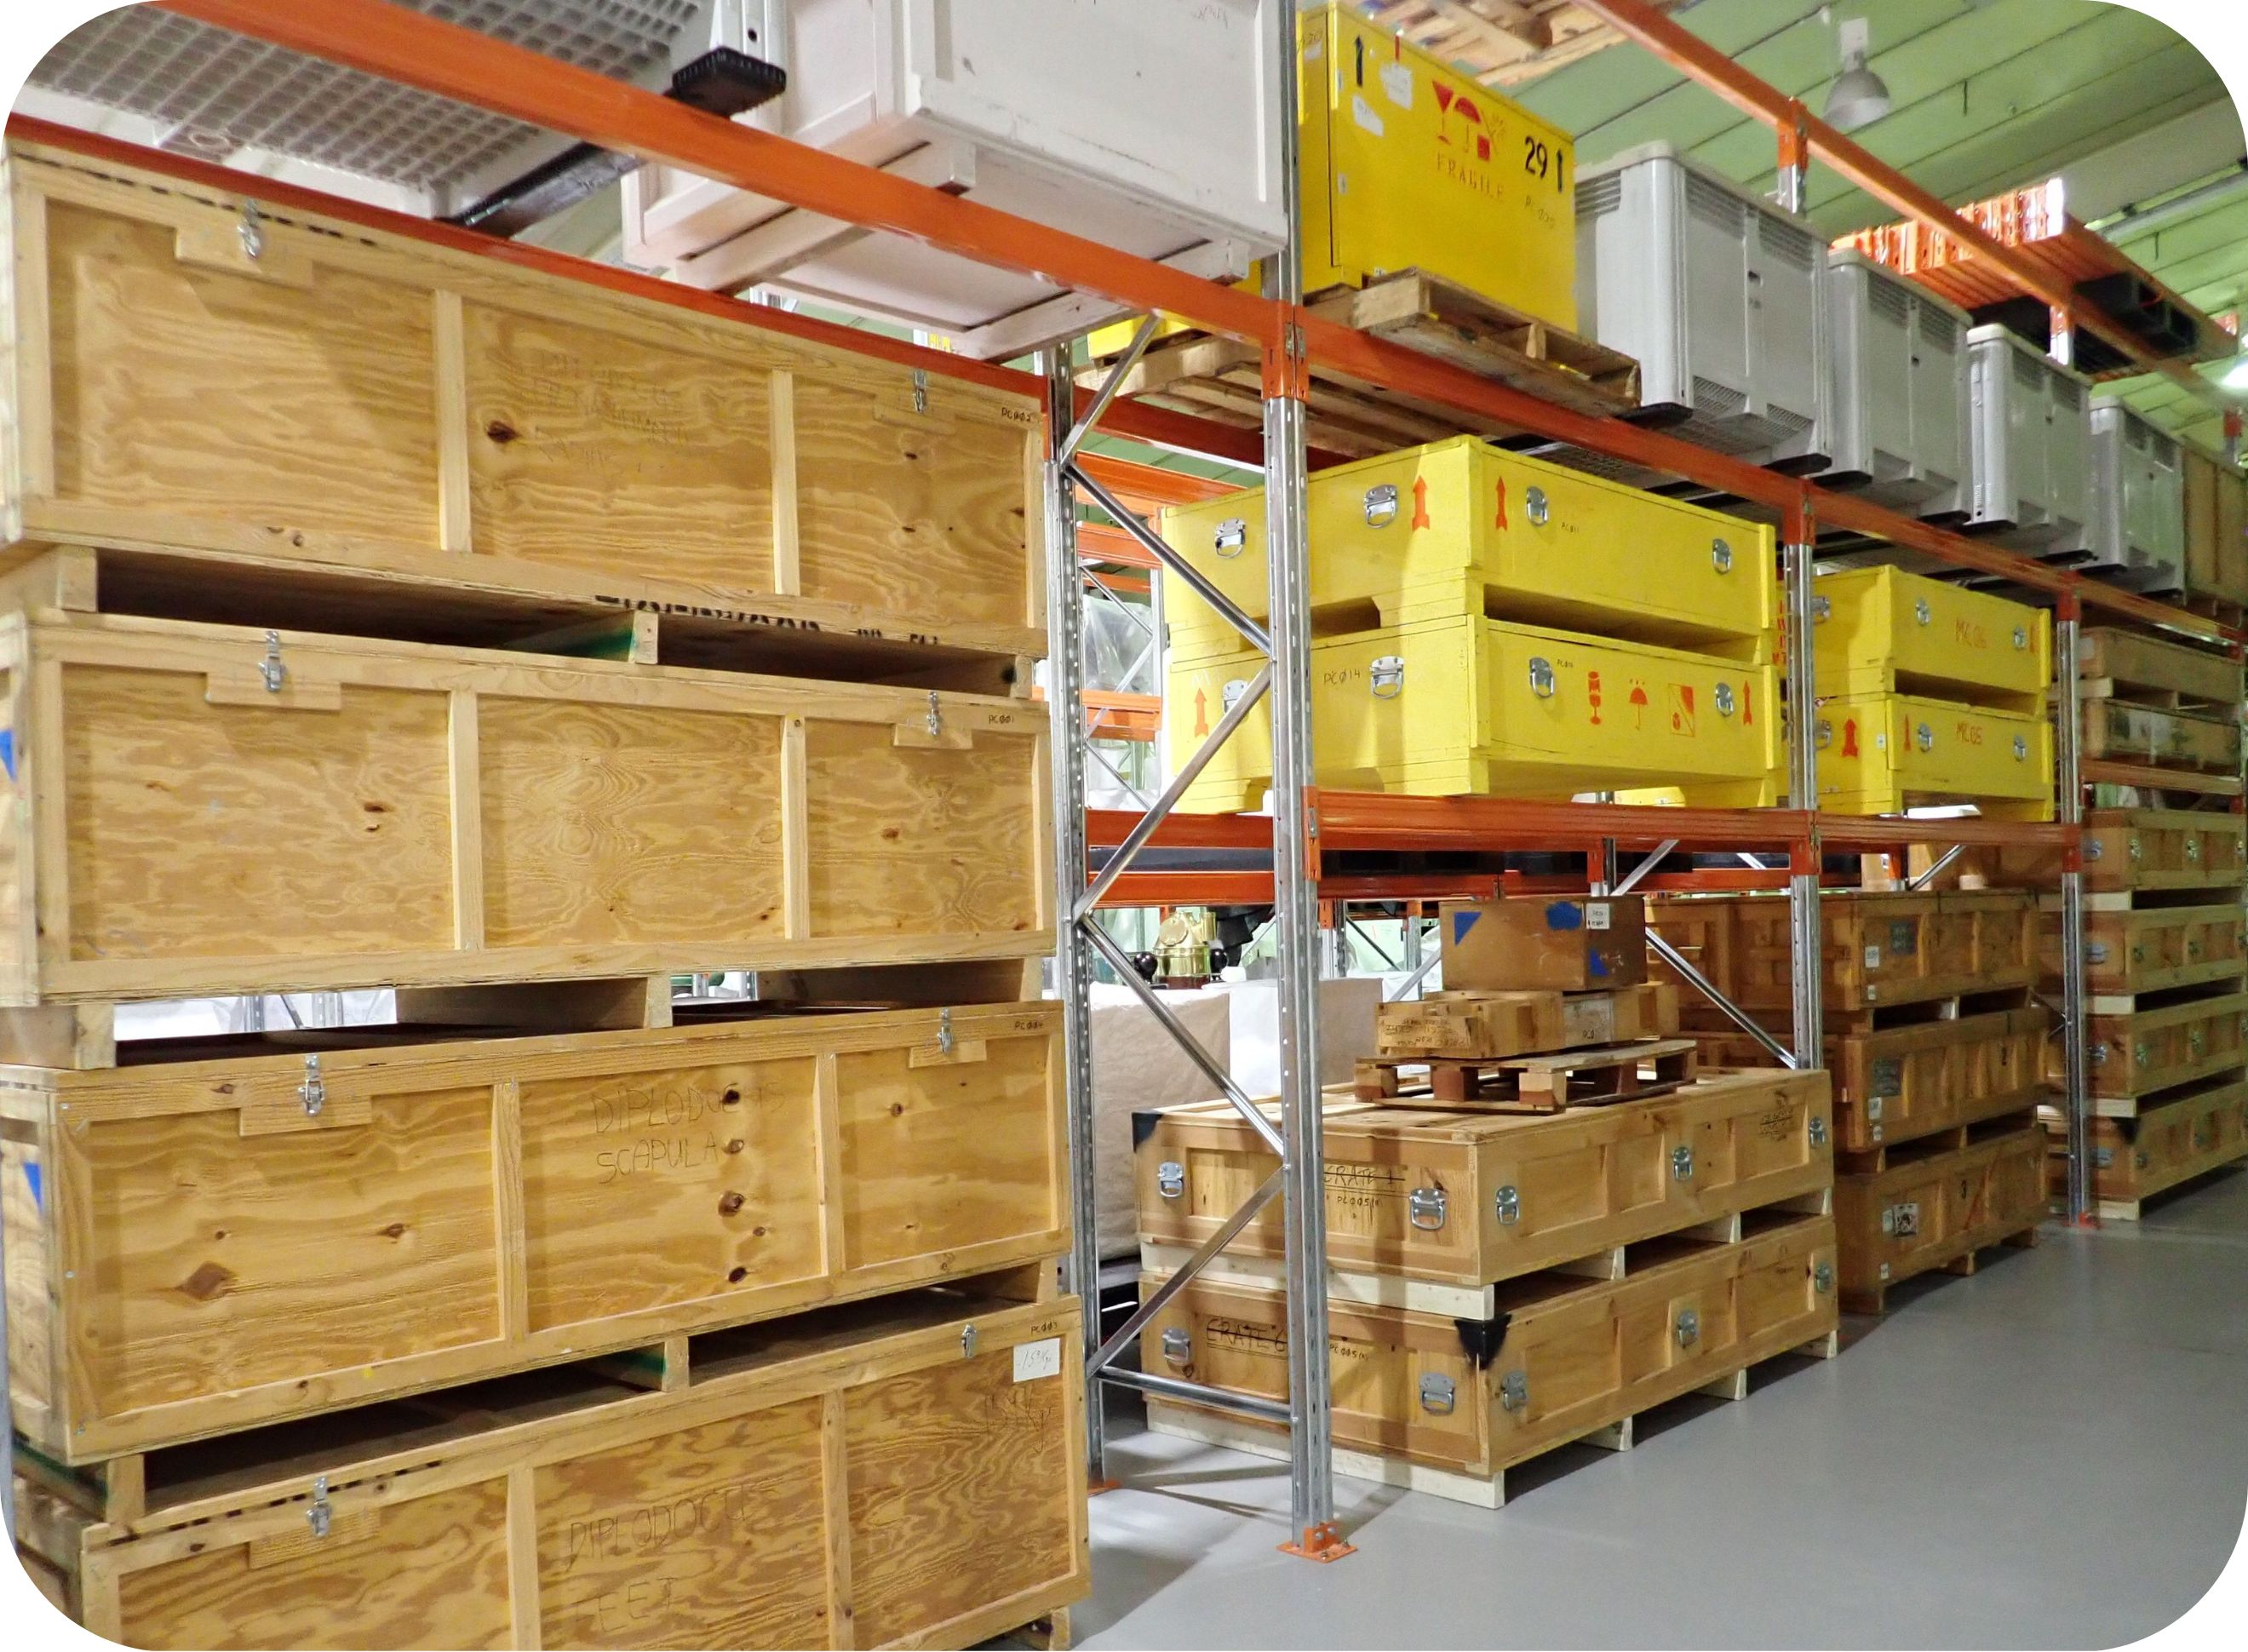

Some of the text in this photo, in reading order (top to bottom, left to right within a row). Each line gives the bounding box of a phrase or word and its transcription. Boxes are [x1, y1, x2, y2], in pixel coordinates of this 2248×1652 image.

[1437, 152, 1503, 202] FRAGILE
[597, 1131, 719, 1185] SCAPULA
[1324, 1164, 1377, 1186] CRATE
[1206, 1319, 1270, 1349] CRATE
[566, 1485, 773, 1573] DIPLODOCU
